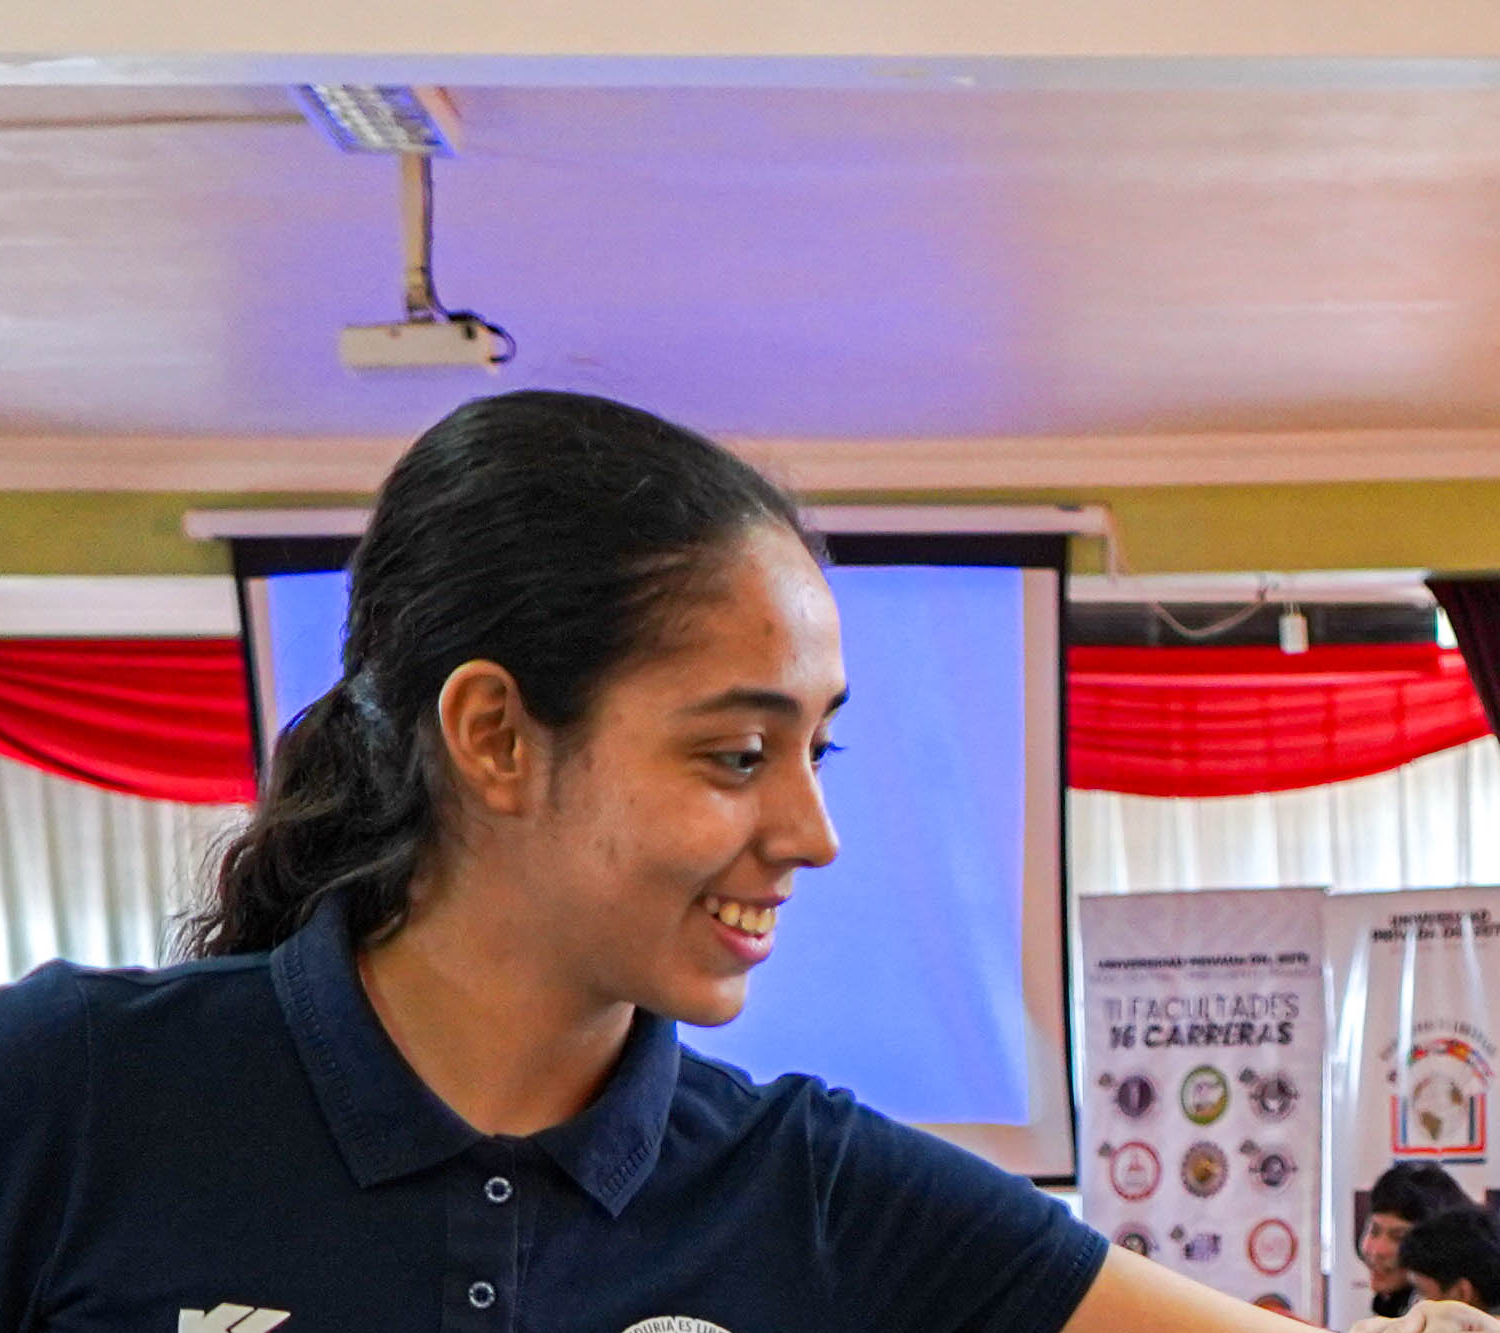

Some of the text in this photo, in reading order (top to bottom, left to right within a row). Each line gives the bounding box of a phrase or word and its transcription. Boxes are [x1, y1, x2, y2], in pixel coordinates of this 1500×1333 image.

[1131, 992, 1300, 1021] FACULTADES
[1144, 1021, 1294, 1048] CARRERAS
[678, 1320, 692, 1333] ES
